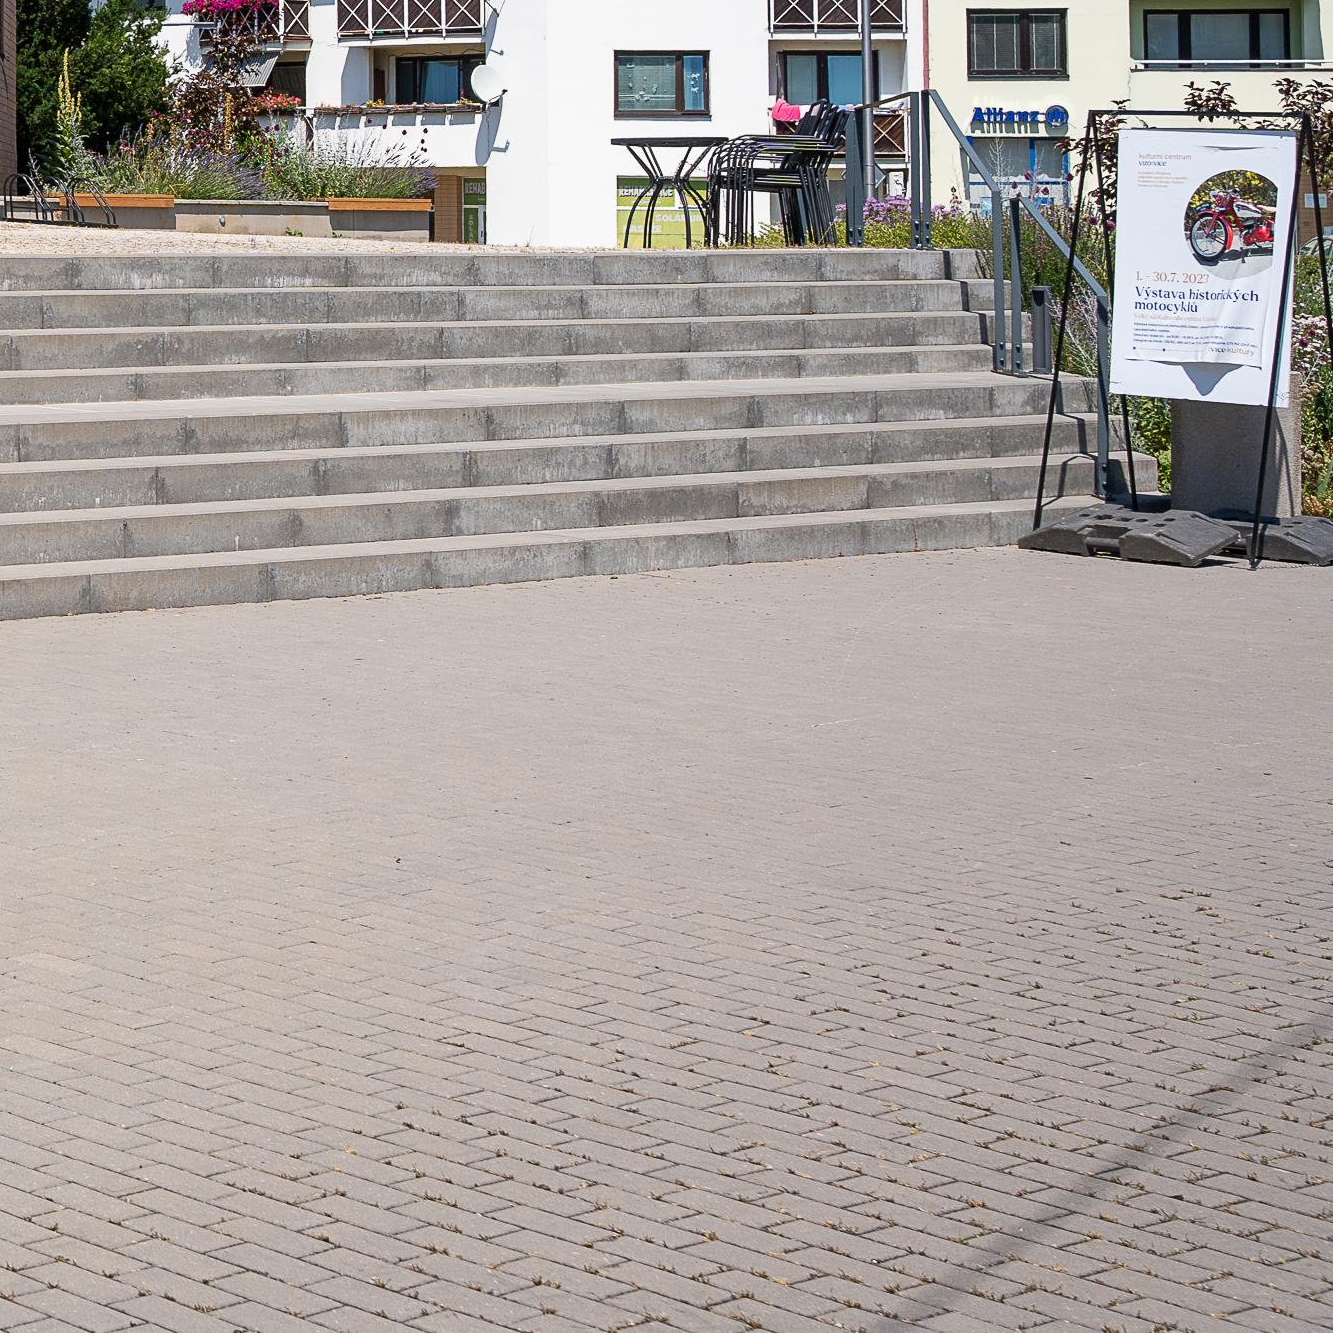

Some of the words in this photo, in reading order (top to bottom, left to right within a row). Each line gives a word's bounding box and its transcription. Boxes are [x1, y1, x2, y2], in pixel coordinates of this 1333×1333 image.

[972, 107, 1039, 123] Allianz
[1183, 272, 1210, 284] 2023
[1135, 286, 1186, 300] Výstava
[1188, 288, 1259, 303] historických
[1134, 301, 1198, 314] motocyklů
